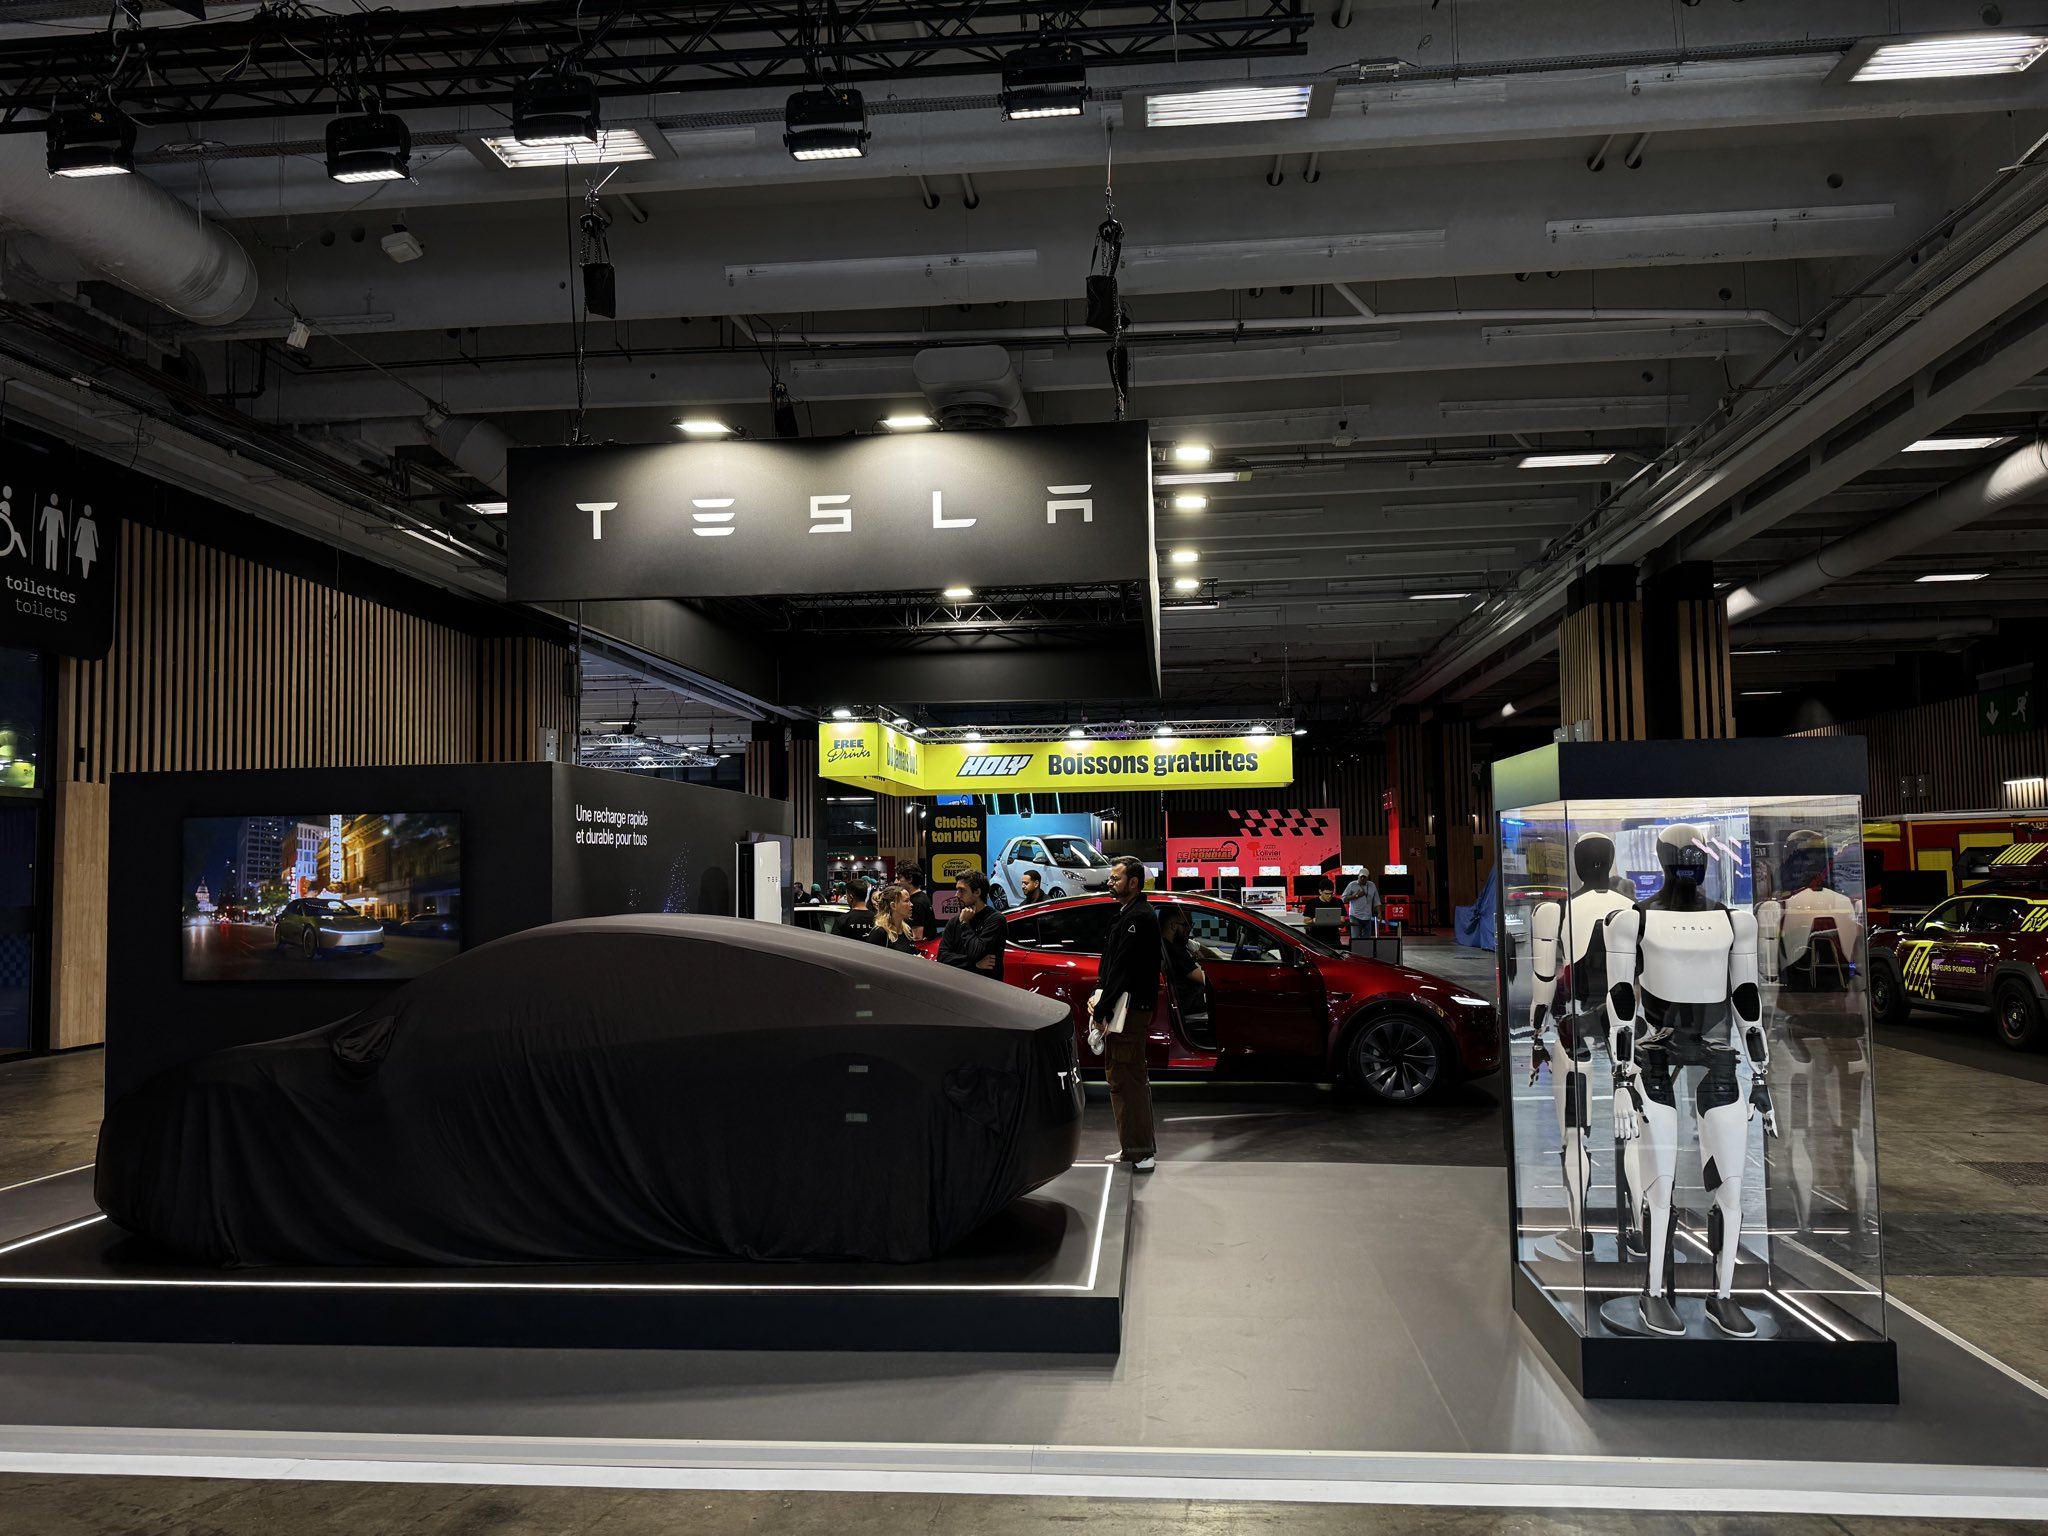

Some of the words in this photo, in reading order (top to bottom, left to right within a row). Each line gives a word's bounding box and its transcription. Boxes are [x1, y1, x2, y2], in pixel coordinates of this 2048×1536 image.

[575, 484, 1093, 540] TESLA
[5, 576, 76, 604] toilettes
[15, 598, 68, 621] toilets
[833, 739, 864, 749] FREE
[827, 747, 870, 763] Drinks
[1048, 753, 1149, 776] Boissons
[1153, 750, 1259, 777] gratuites
[958, 754, 1032, 777] HOLY
[575, 804, 592, 822] Une
[593, 807, 626, 828] recharge
[627, 811, 649, 828] rapide
[934, 816, 978, 829] Choisis
[575, 829, 585, 844] et
[585, 828, 614, 845] durable
[615, 832, 632, 848] pour
[632, 832, 648, 846] tous
[931, 830, 953, 843] ton
[953, 830, 981, 843] HOLY
[1177, 851, 1190, 859] LE
[942, 905, 958, 914] ICED
